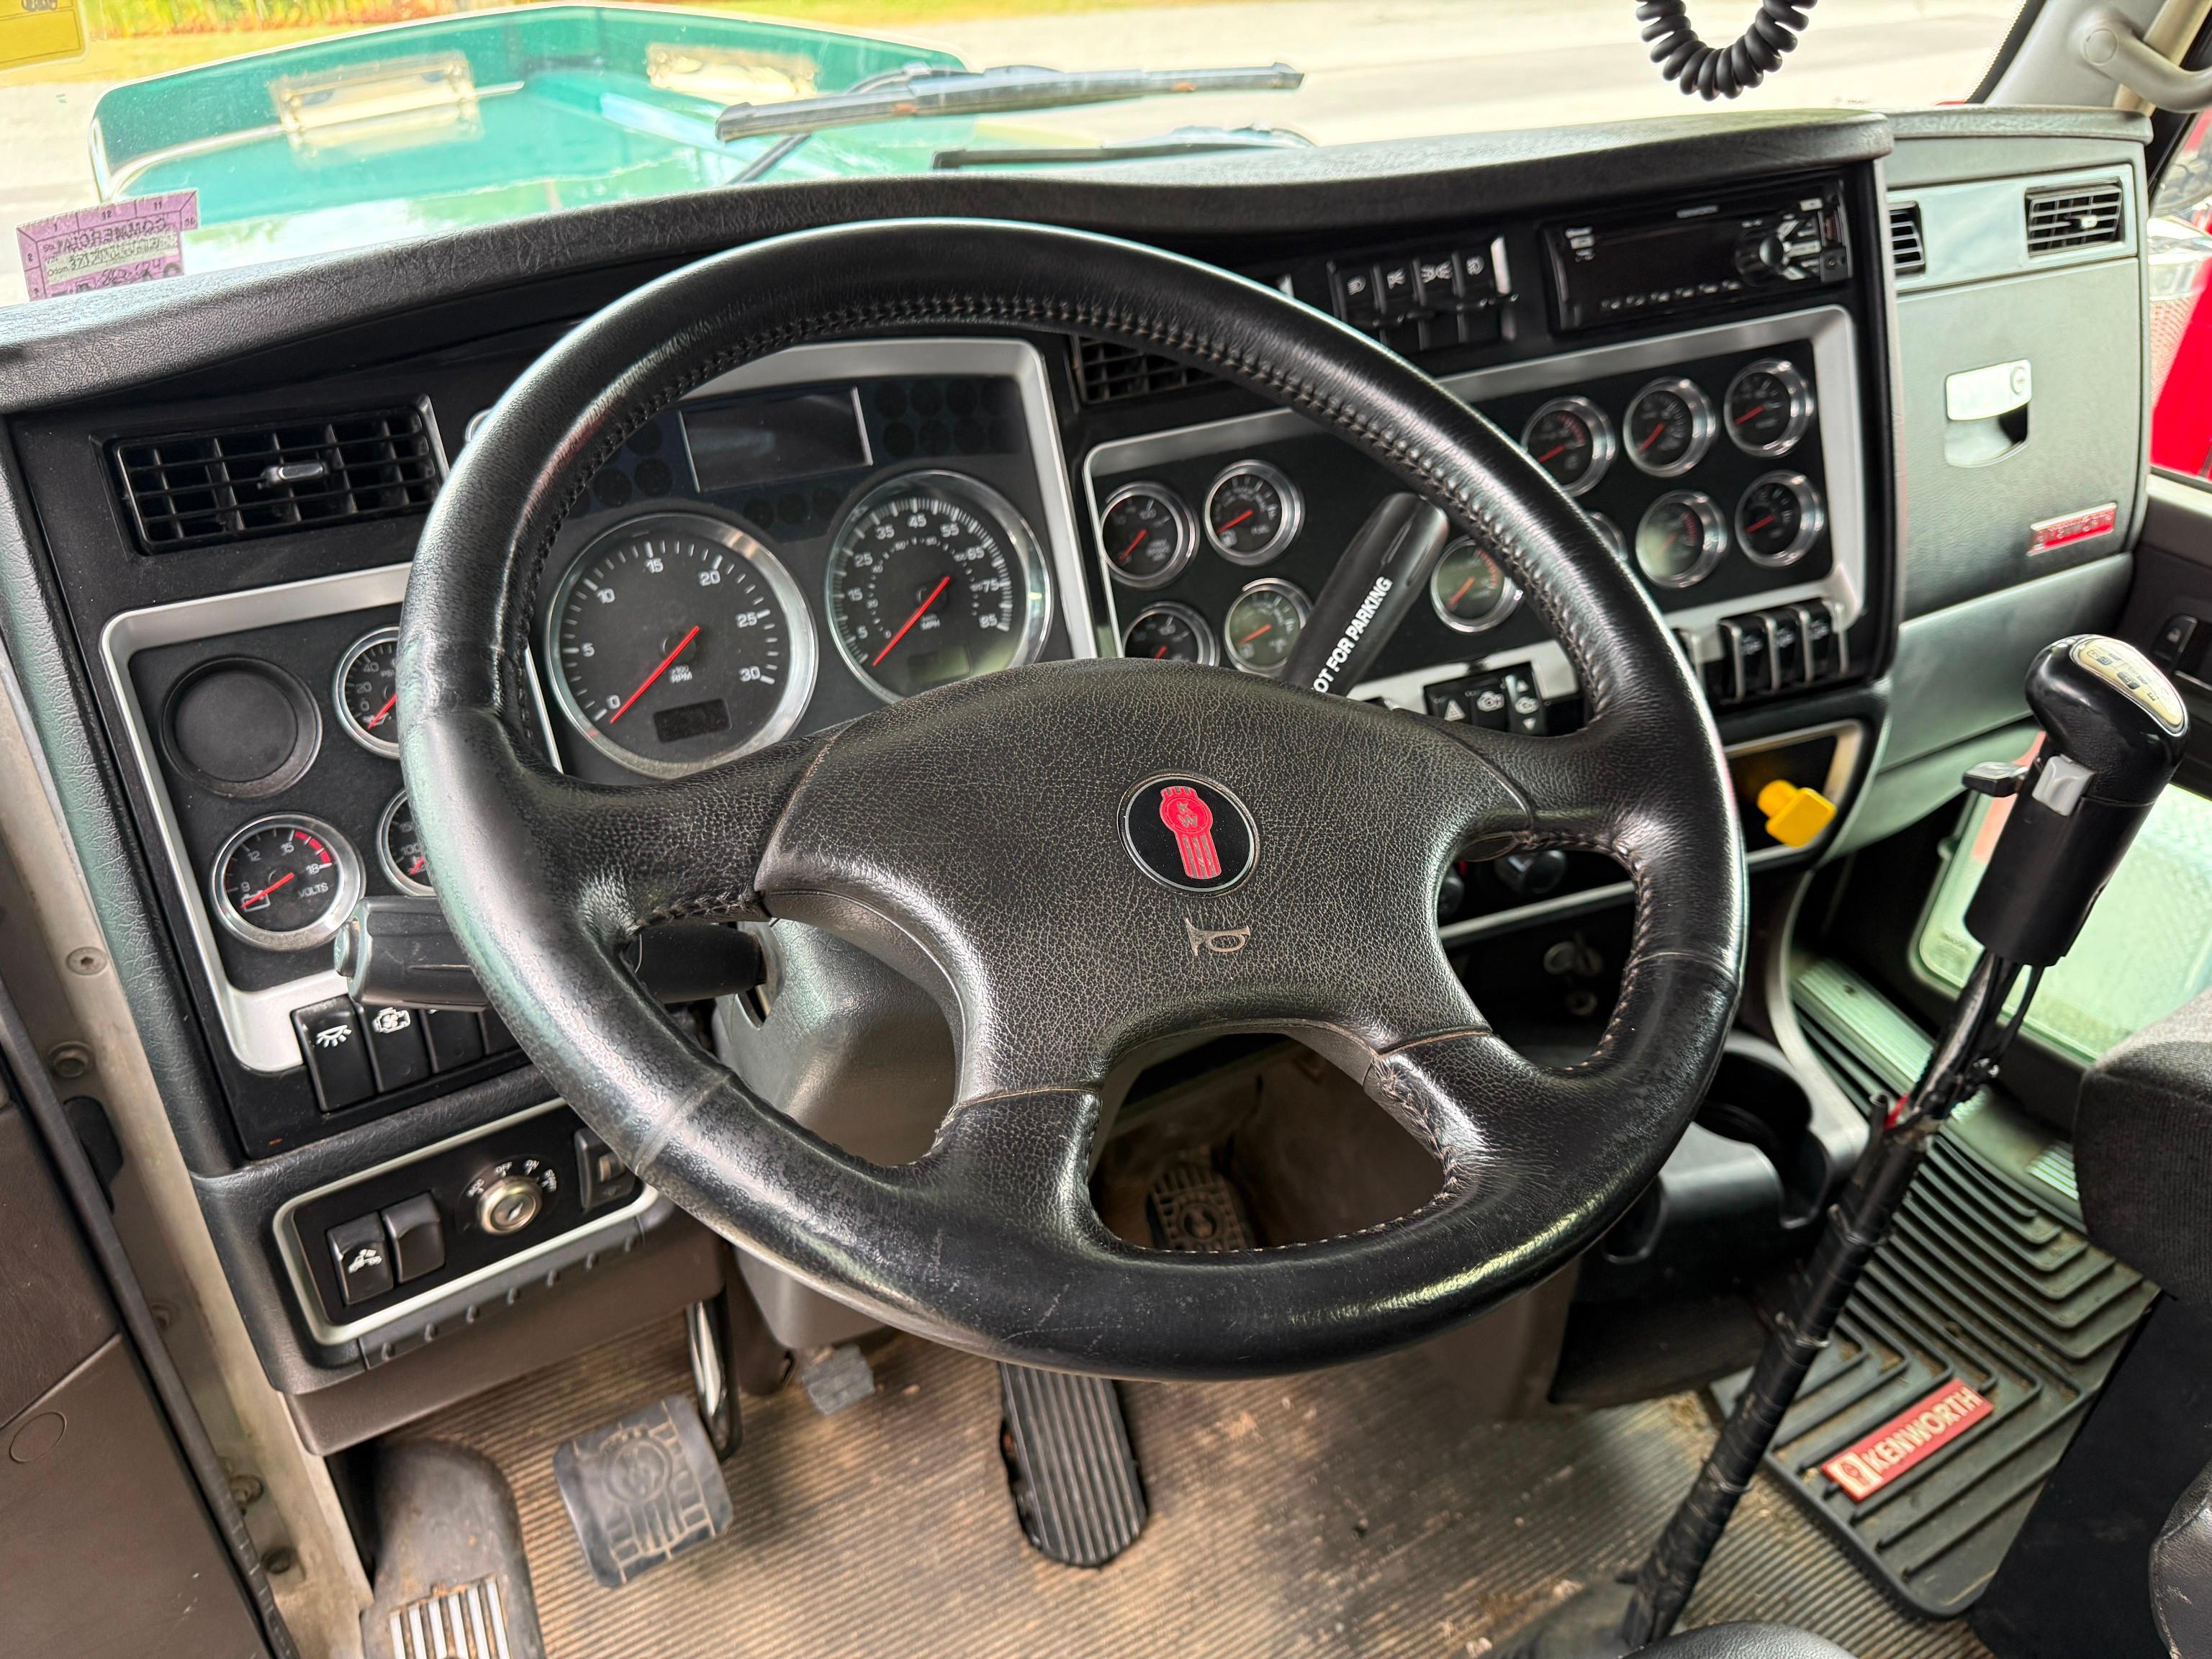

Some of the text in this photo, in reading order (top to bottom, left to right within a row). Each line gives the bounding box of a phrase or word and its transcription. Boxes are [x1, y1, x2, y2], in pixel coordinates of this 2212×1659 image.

[154, 201, 162, 210] 11
[101, 209, 112, 220] 12
[27, 253, 34, 262] 2
[907, 513, 926, 528] 45
[875, 525, 895, 540] 35
[940, 523, 959, 538] 55
[854, 553, 873, 568] 25
[967, 546, 985, 561] 65
[646, 559, 664, 573] 15
[699, 569, 720, 586] 20
[982, 577, 1000, 593] 75
[597, 589, 615, 604] 10
[848, 587, 863, 602] 15
[736, 613, 758, 628] 25
[978, 612, 998, 629] 85
[856, 625, 868, 640] 5
[1312, 577, 1393, 692] OT FOR PARKING
[582, 643, 595, 657] 5
[364, 661, 379, 672] 40
[739, 666, 761, 682] 30
[357, 681, 372, 694] 20
[360, 700, 369, 712] 0
[606, 695, 621, 710] 0
[281, 842, 294, 854] 15
[402, 842, 422, 856] 100
[248, 850, 261, 862] 12
[306, 863, 320, 875] 18
[241, 882, 250, 892] 9
[298, 882, 329, 899] VOLTS
[523, 1159, 540, 1175] ON
[1861, 1386, 1983, 1474] KENWORTH
